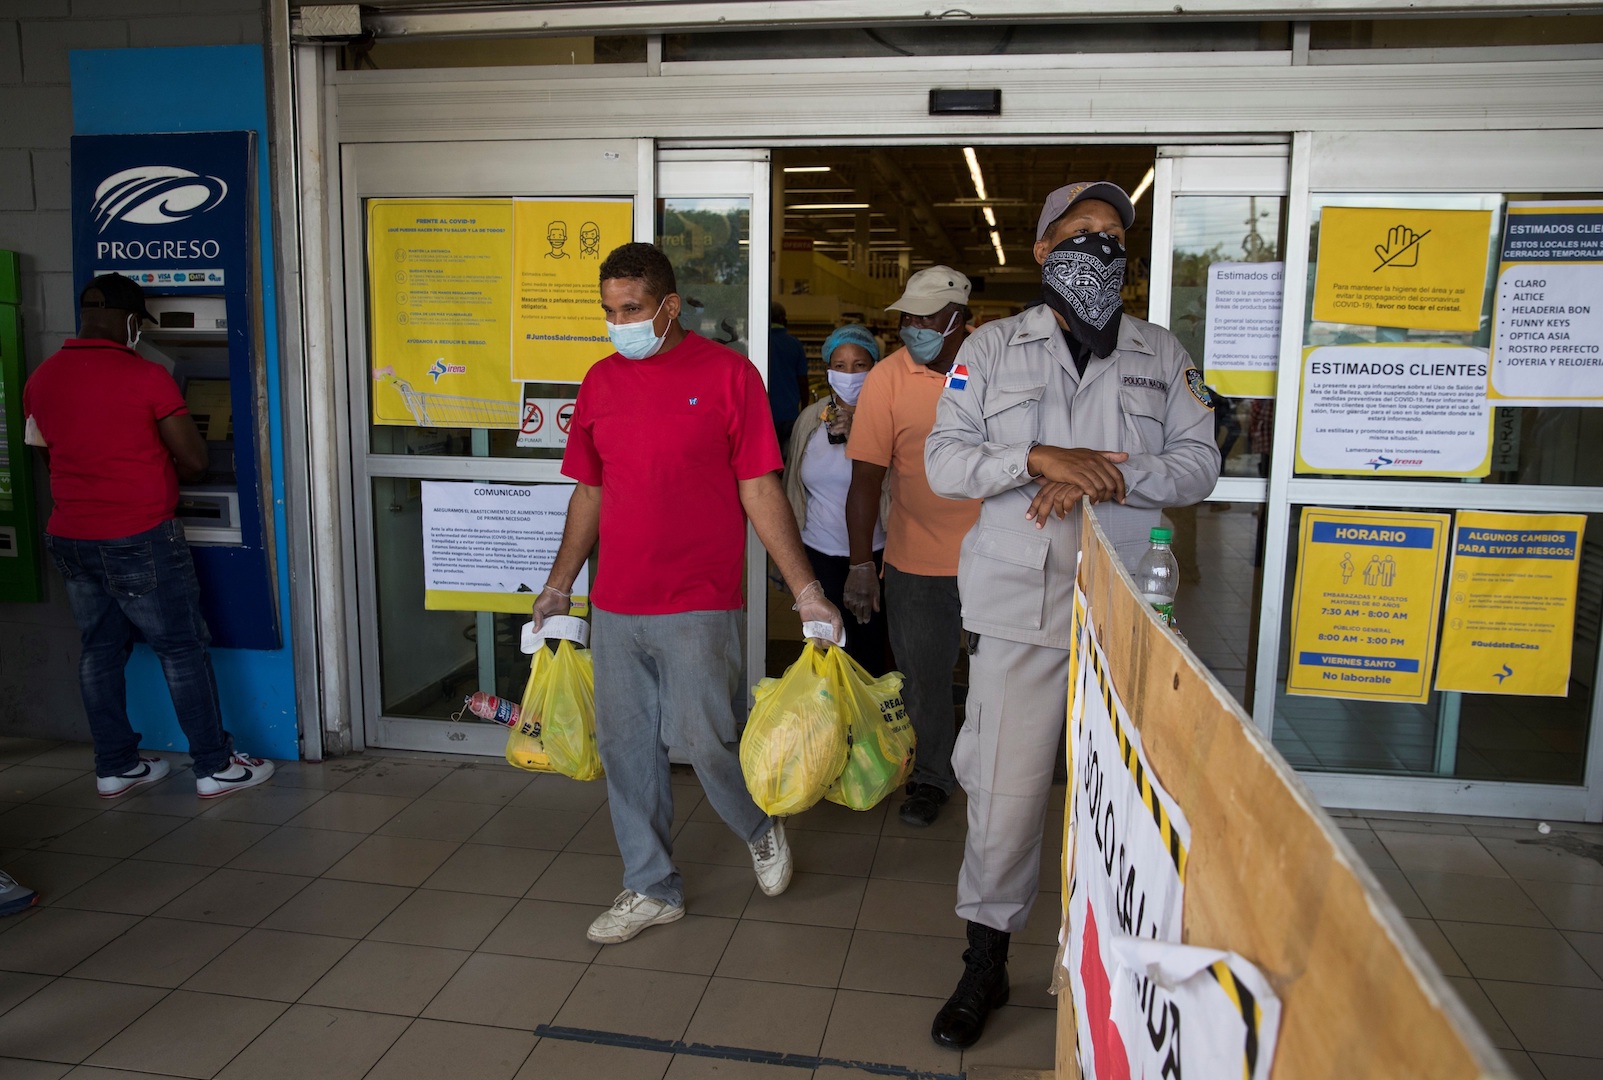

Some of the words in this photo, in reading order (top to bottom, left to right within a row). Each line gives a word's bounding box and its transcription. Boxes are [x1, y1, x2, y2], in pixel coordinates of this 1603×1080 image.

[1510, 225, 1574, 234] ESTIMADOS
[97, 240, 220, 260] PROGRESO
[1217, 271, 1268, 280] Estimados
[1271, 272, 1282, 280] cli
[1514, 279, 1546, 288] CLARO
[1392, 285, 1418, 294] higiene
[1364, 295, 1406, 303] propagación
[1333, 301, 1374, 310] (COVID-19),
[1312, 363, 1404, 375] ESTIMADOS
[1410, 364, 1487, 376] CLIENTES
[1124, 377, 1147, 385] POLICIA
[474, 488, 531, 497] COMUNICADO
[1335, 527, 1406, 542] HORARIO
[1468, 532, 1519, 542] ALGUNOS
[1520, 534, 1565, 543] CAMBIOS
[1458, 544, 1486, 554] PARA
[1489, 545, 1524, 555] EVITAR
[1526, 546, 1573, 556] RIESGOS:
[1471, 641, 1539, 650] #QuédateEnCasa
[1322, 657, 1362, 666] VIERNES
[1364, 659, 1395, 668] SANTO
[1322, 672, 1338, 680] No
[1340, 673, 1391, 683] laborable
[1084, 730, 1116, 878] SOLO
